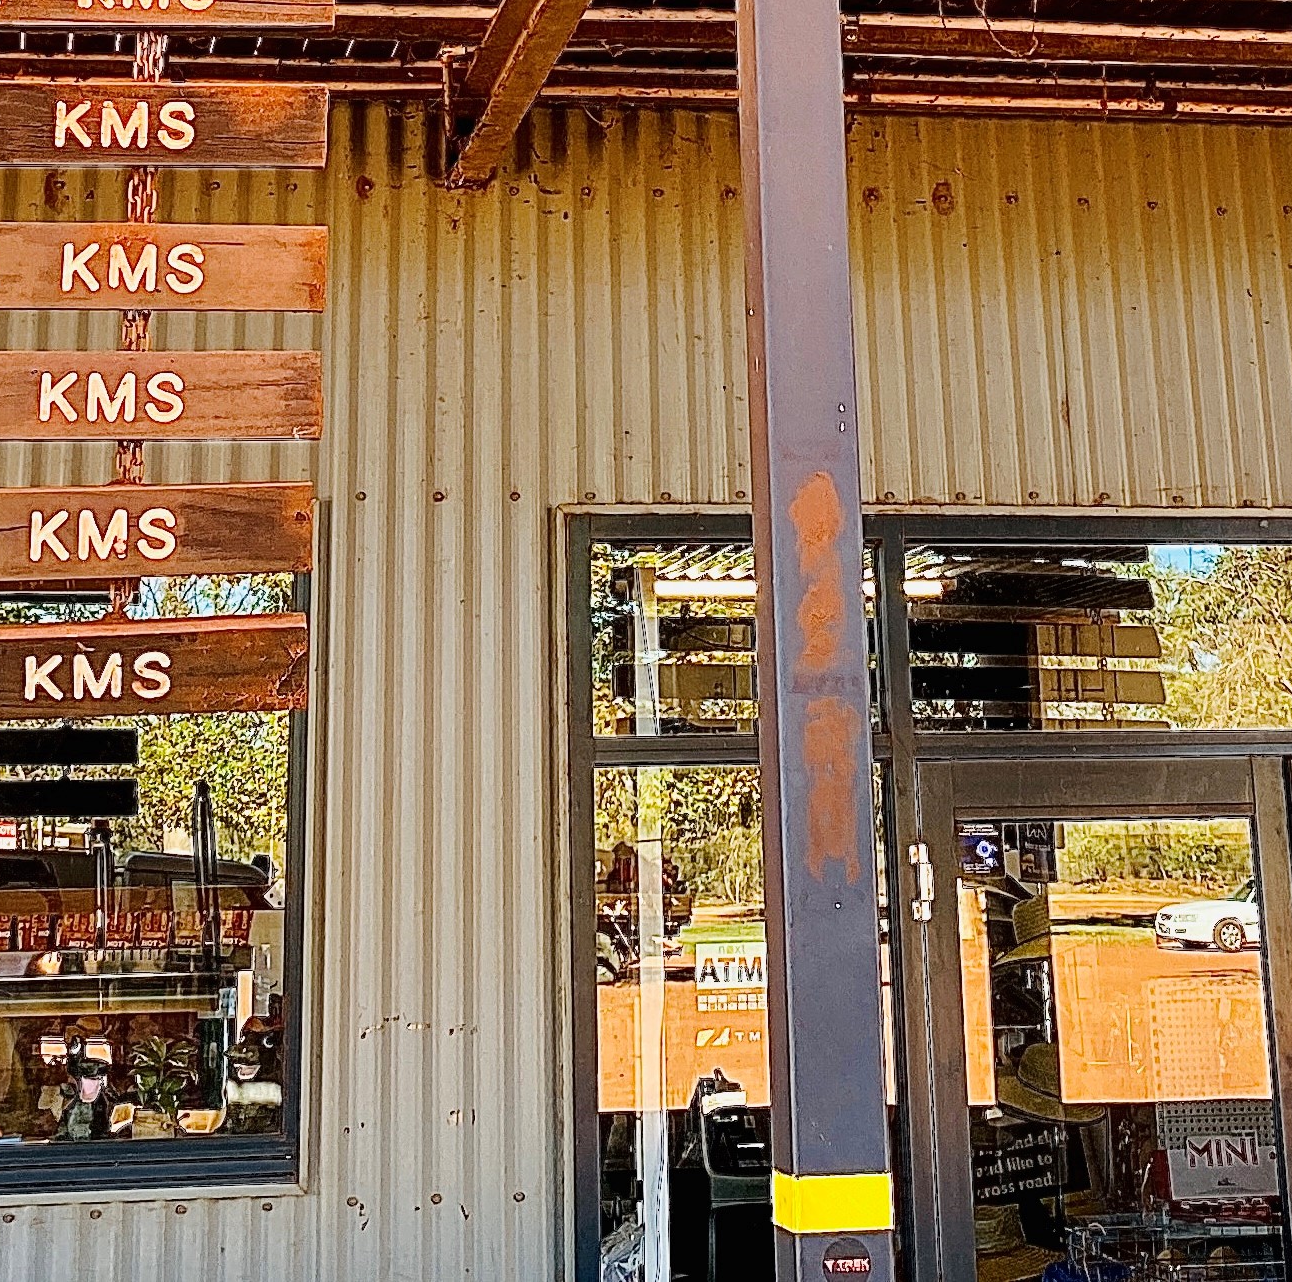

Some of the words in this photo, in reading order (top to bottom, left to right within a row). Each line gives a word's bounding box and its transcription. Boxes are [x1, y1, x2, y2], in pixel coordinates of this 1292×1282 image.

[52, 98, 198, 152] KMS
[59, 240, 207, 296] KMS
[37, 370, 186, 425] KMS
[27, 505, 178, 564] KMS
[22, 649, 173, 703] KMS
[698, 957, 763, 983] ATM
[1187, 1137, 1259, 1168] MINI
